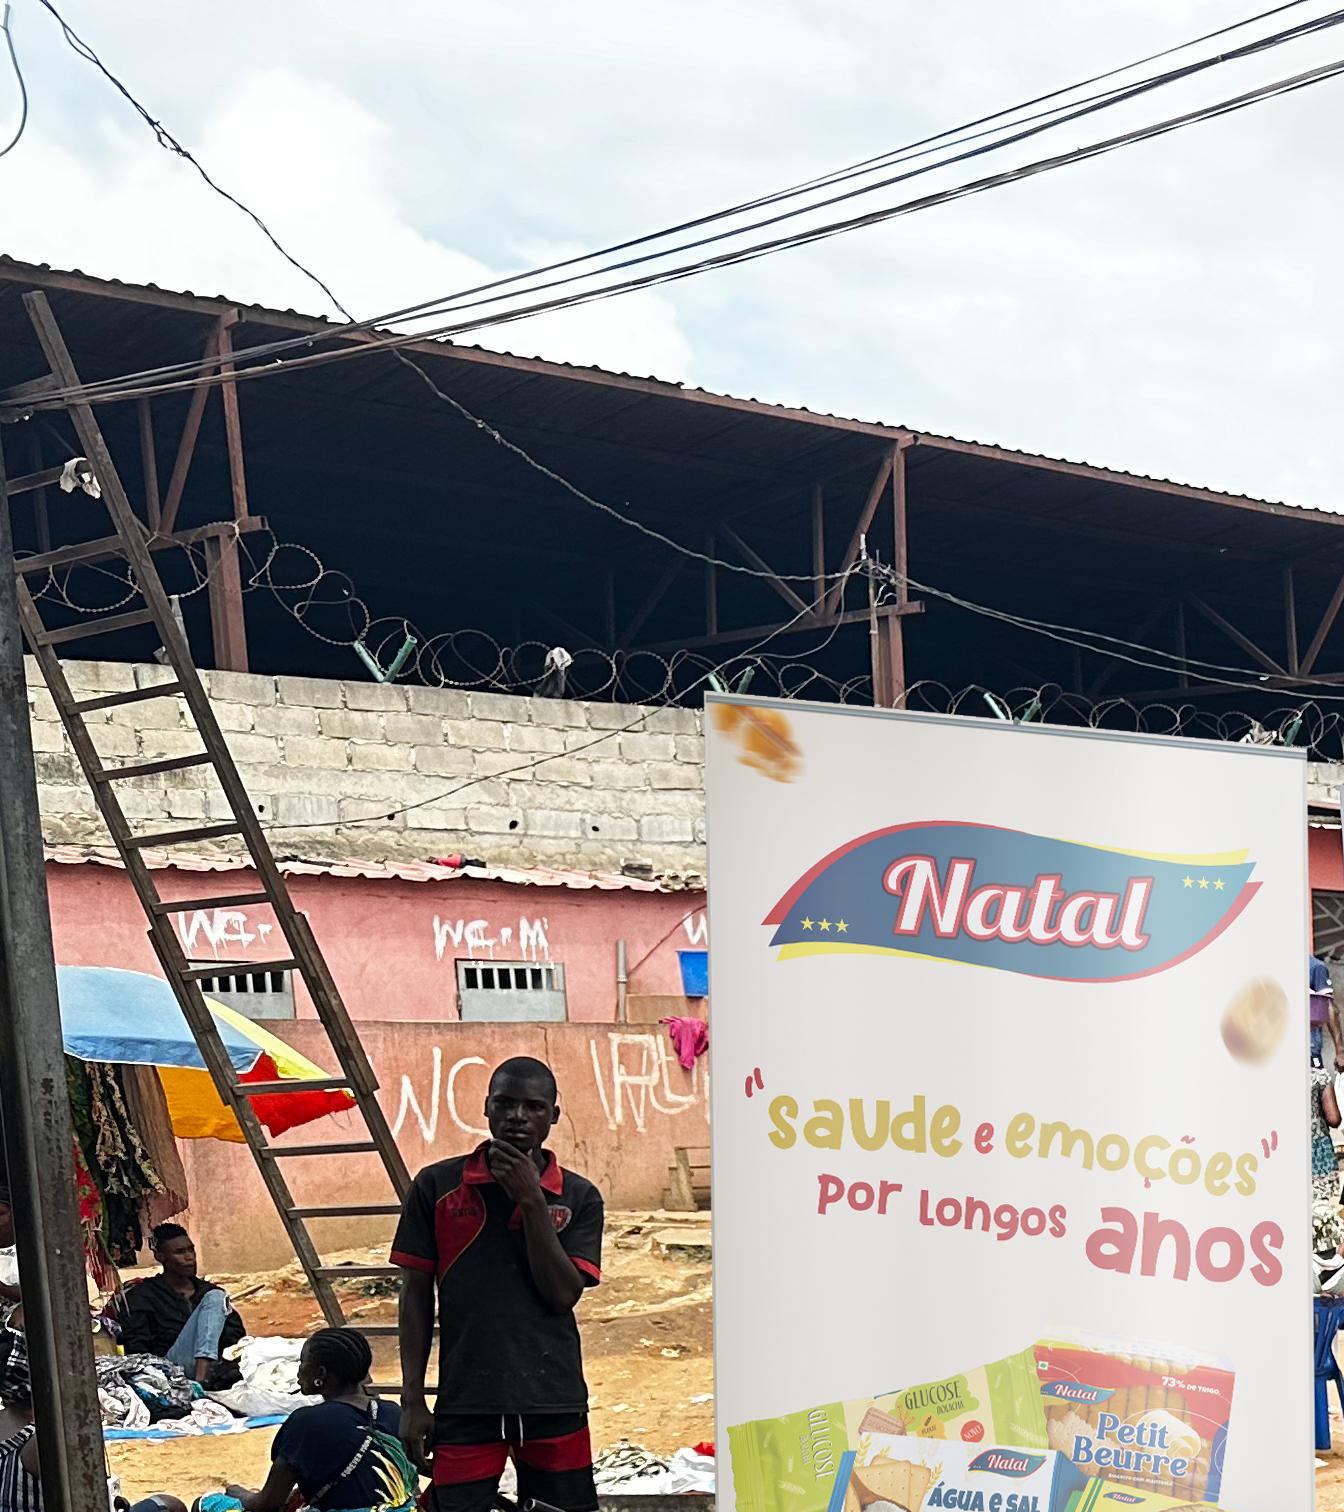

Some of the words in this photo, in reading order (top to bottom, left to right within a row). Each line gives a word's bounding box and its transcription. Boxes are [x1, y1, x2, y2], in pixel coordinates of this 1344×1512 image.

[885, 855, 1155, 952] Natal
[974, 1121, 994, 1154] e
[817, 1173, 902, 1216] por
[1085, 1207, 1284, 1287] anos
[904, 1380, 962, 1410] GLUCOSE
[1054, 1384, 1098, 1401] Natal
[1097, 1412, 1169, 1449] Petit
[987, 1454, 1029, 1471] Natal
[1072, 1436, 1188, 1477] Beurre
[928, 1482, 981, 1512] ÁGUA
